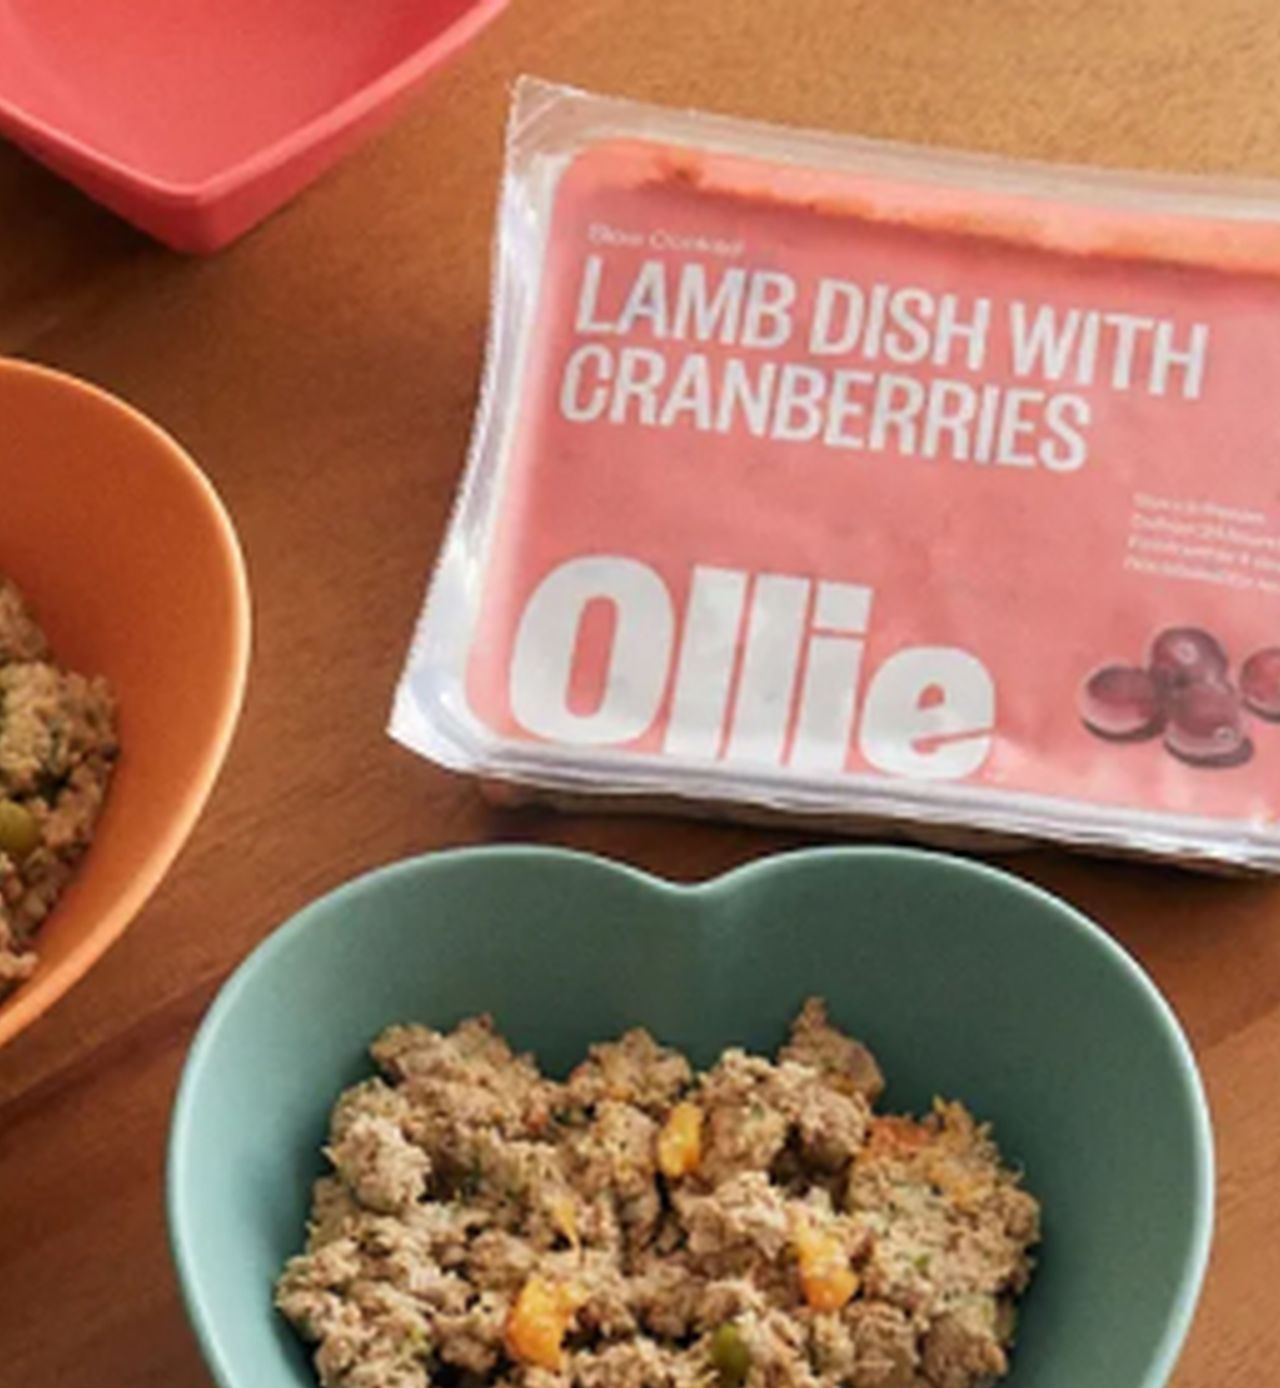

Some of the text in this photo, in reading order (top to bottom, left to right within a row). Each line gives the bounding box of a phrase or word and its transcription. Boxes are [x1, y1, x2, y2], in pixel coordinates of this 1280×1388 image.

[576, 256, 1208, 398] LAMB DISH WITH
[561, 344, 1090, 471] CRANBERRIES
[509, 555, 996, 782] Ollie
